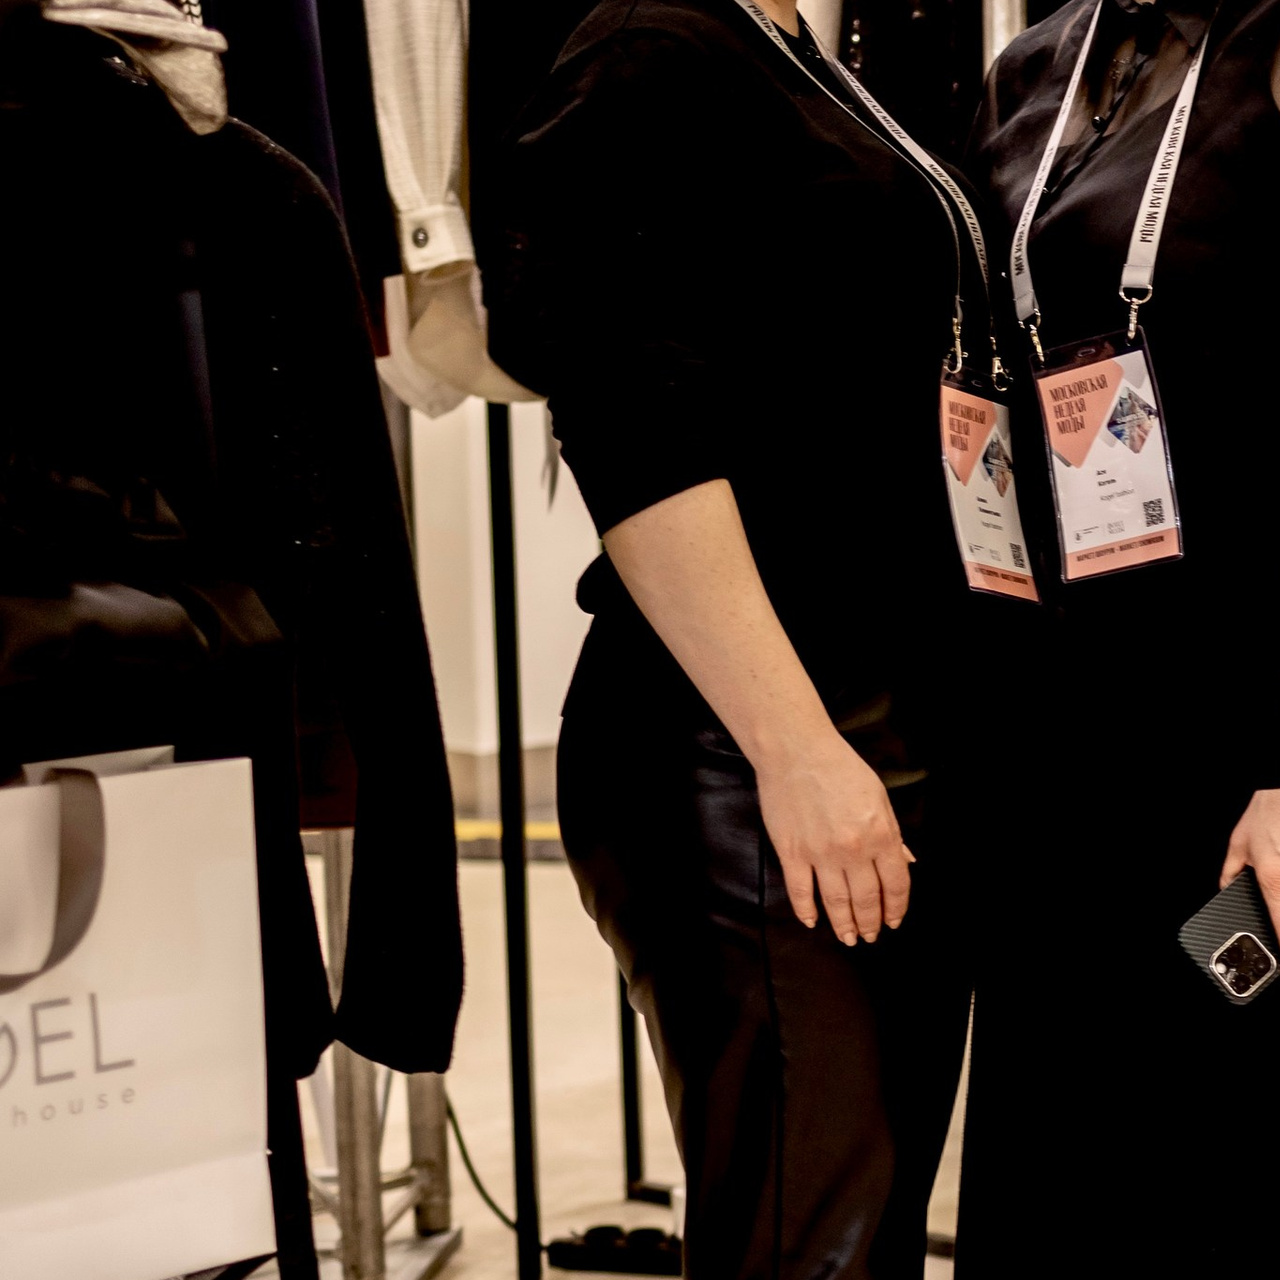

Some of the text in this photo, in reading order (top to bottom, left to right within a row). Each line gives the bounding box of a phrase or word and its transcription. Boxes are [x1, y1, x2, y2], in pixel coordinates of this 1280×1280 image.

[1149, 171, 1170, 209] НЕДЕЛЯ
[1139, 209, 1160, 243] МОДЫ
[1049, 374, 1109, 403] МОСКОВСКАЯ
[1053, 397, 1087, 420] НЕДЕЛЯ
[1057, 418, 1086, 436] МОДЫ
[0, 992, 135, 1088] EL
[12, 1087, 136, 1127] house
